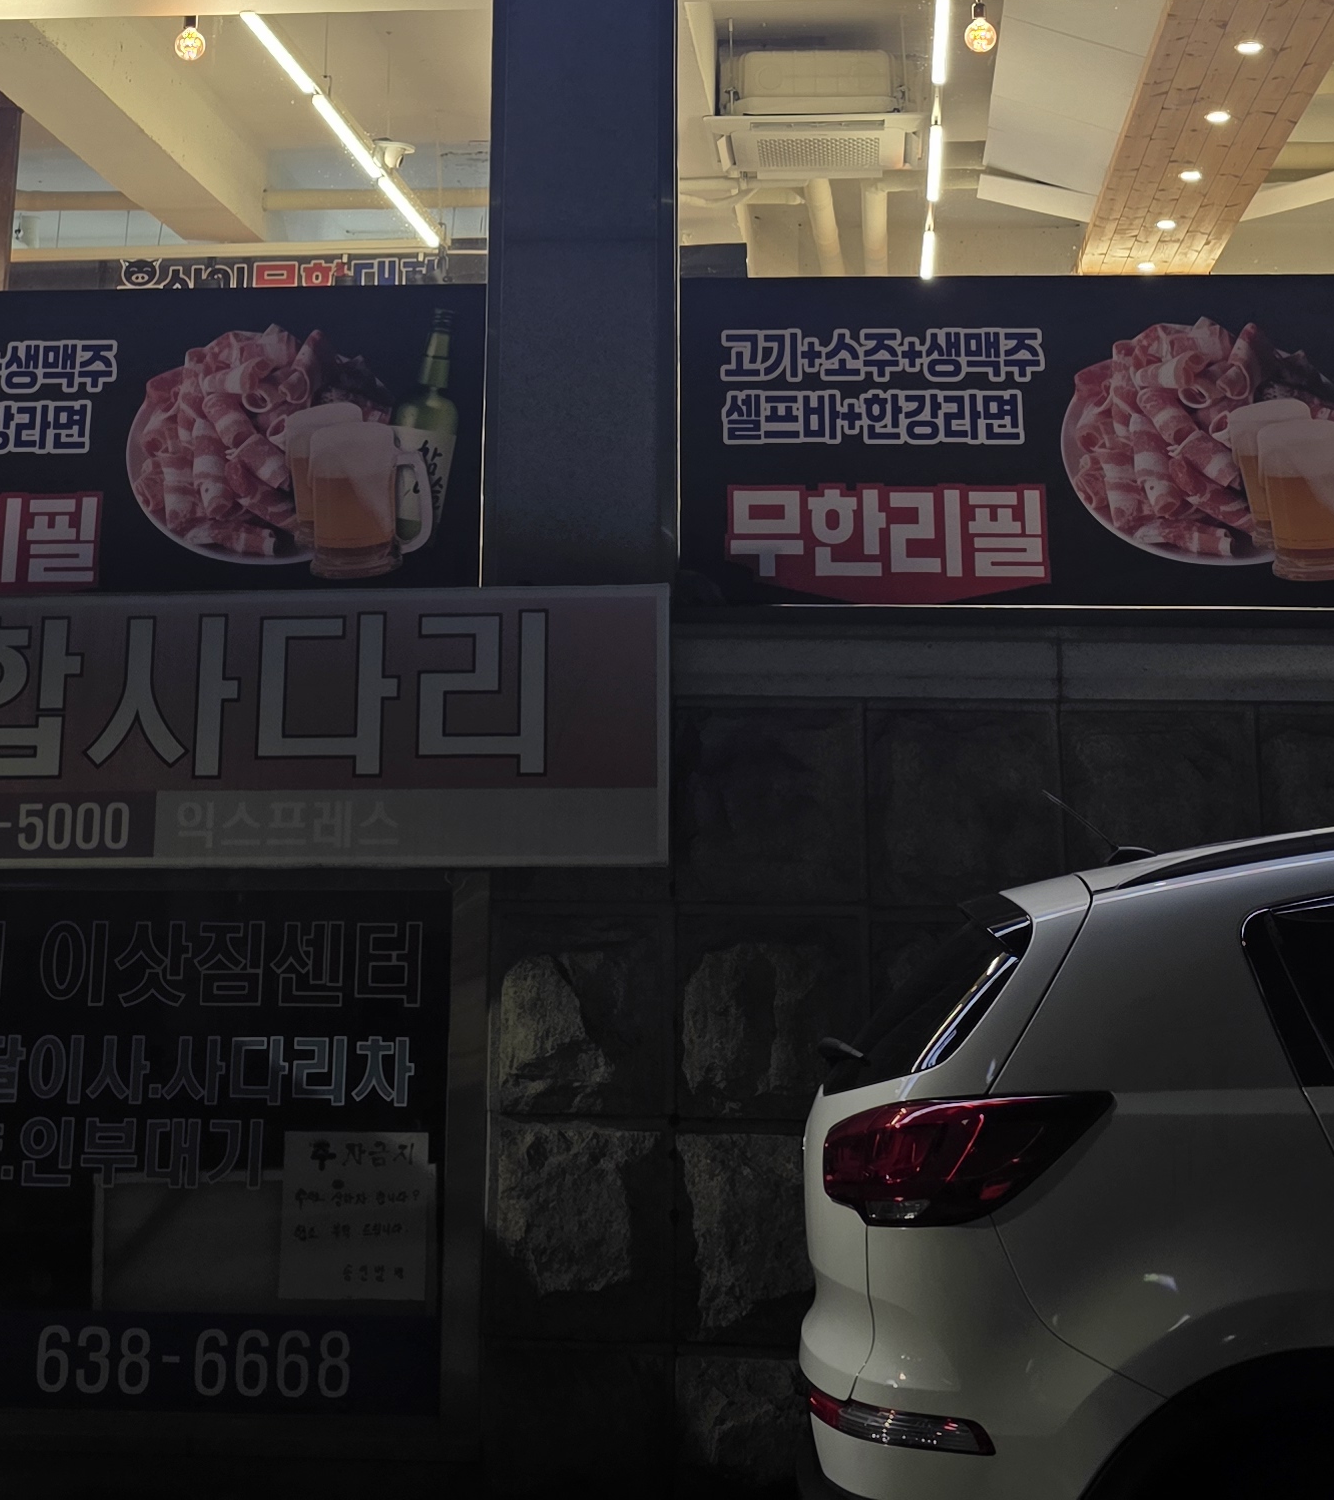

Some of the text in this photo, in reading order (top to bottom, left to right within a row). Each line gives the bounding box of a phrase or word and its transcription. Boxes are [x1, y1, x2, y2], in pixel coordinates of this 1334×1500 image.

[720, 328, 1045, 383] 고기+소주+생맥주
[721, 389, 1025, 445] 셀프바+한강라면
[730, 489, 1045, 578] 무한리필
[39, 919, 425, 1008] 이삿짐센터
[35, 1323, 352, 1399] 638-6668
